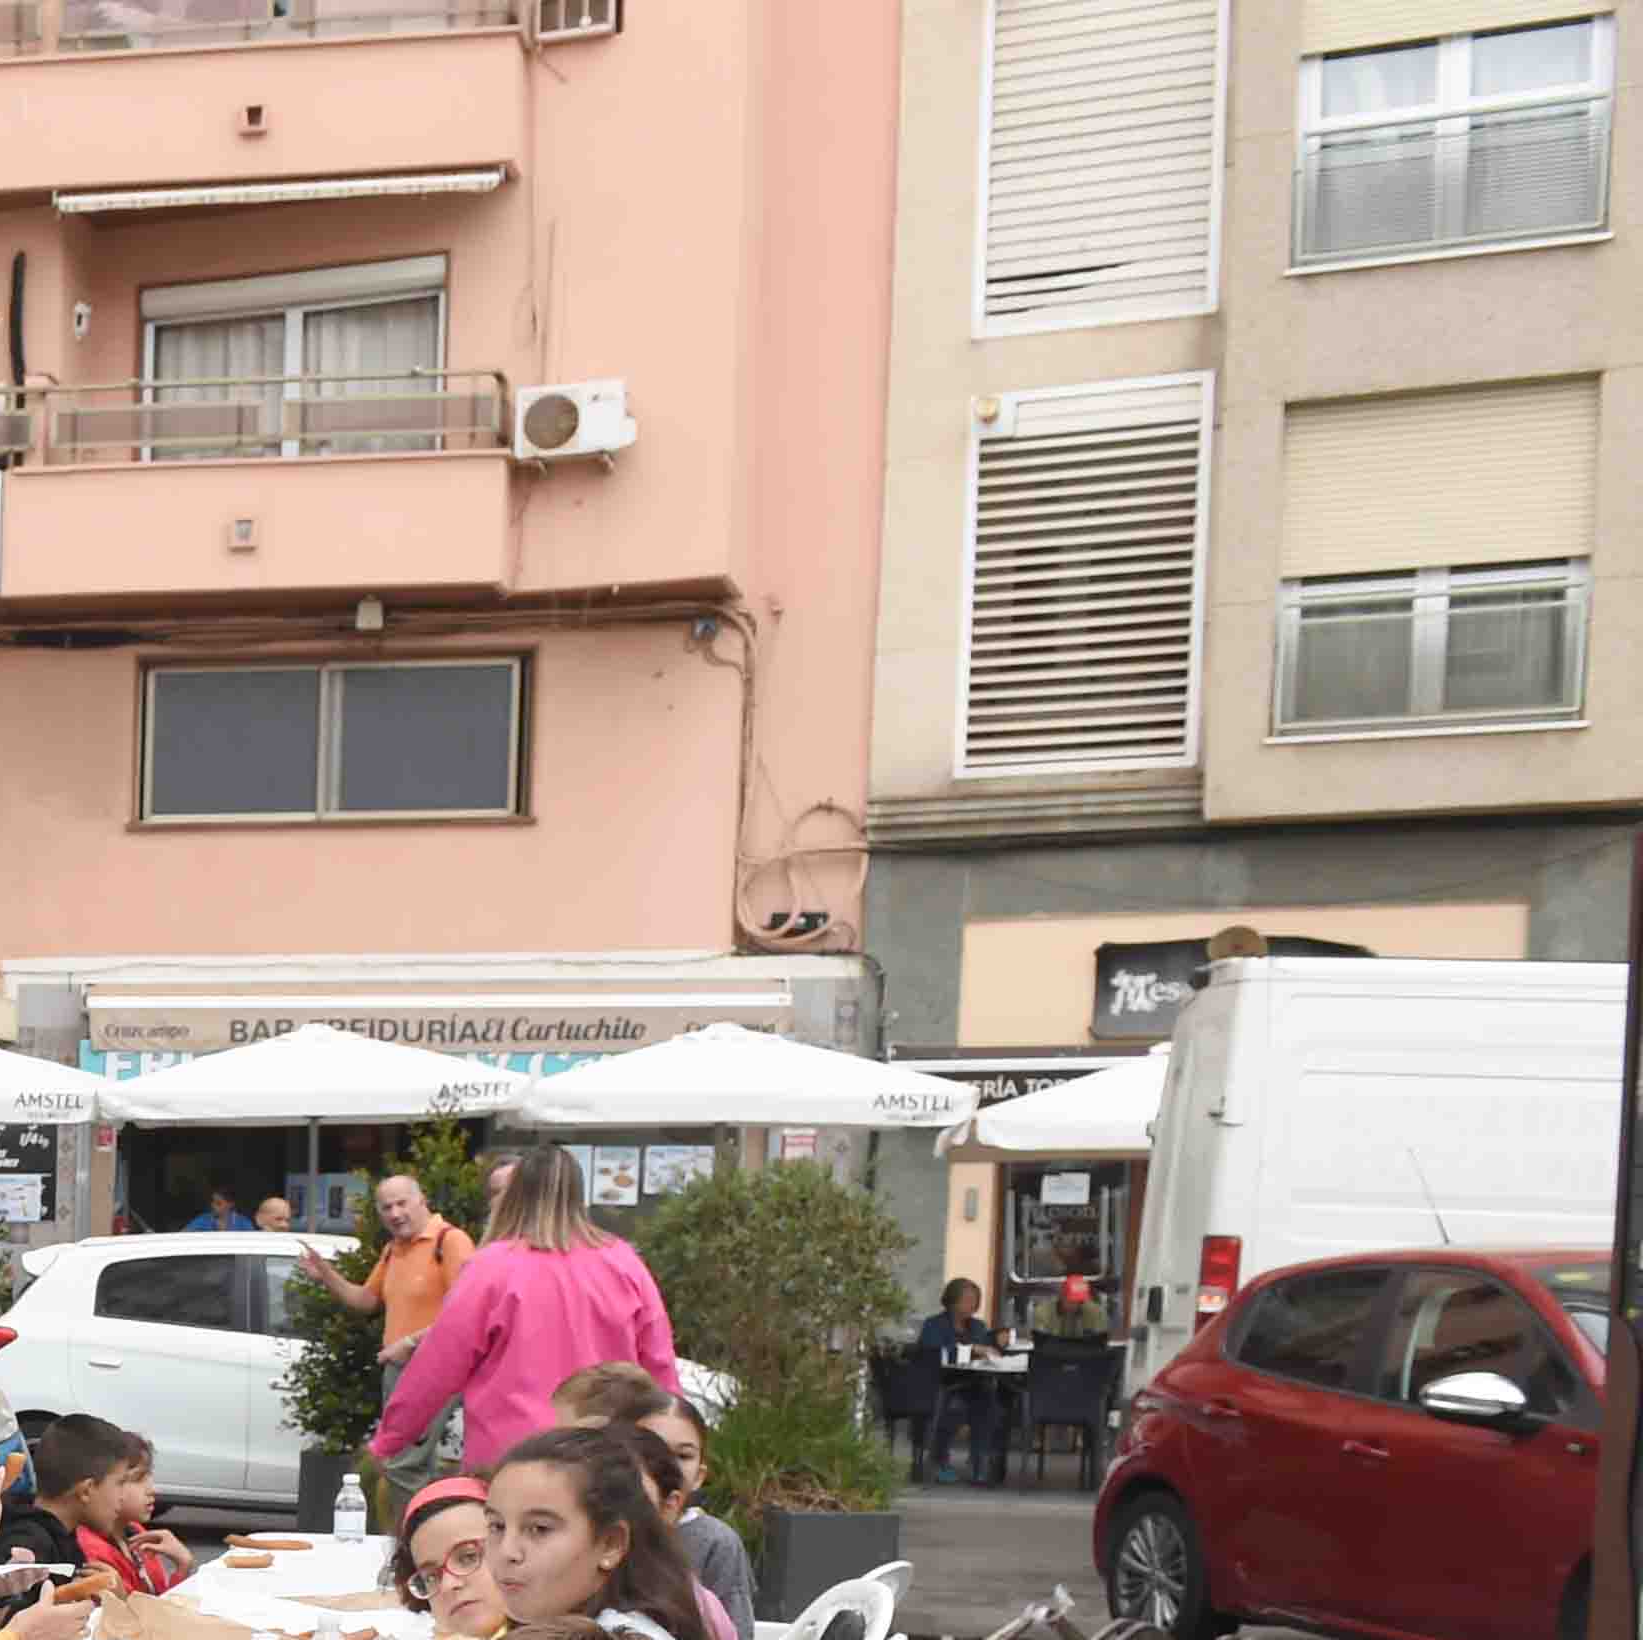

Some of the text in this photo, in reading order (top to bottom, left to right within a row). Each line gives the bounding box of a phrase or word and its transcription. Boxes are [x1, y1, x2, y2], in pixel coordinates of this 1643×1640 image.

[230, 1018, 295, 1043] BAR
[309, 1013, 481, 1044] REIDURÍA
[510, 1016, 648, 1044] Cartuchito
[15, 1091, 84, 1110] AMSTEL
